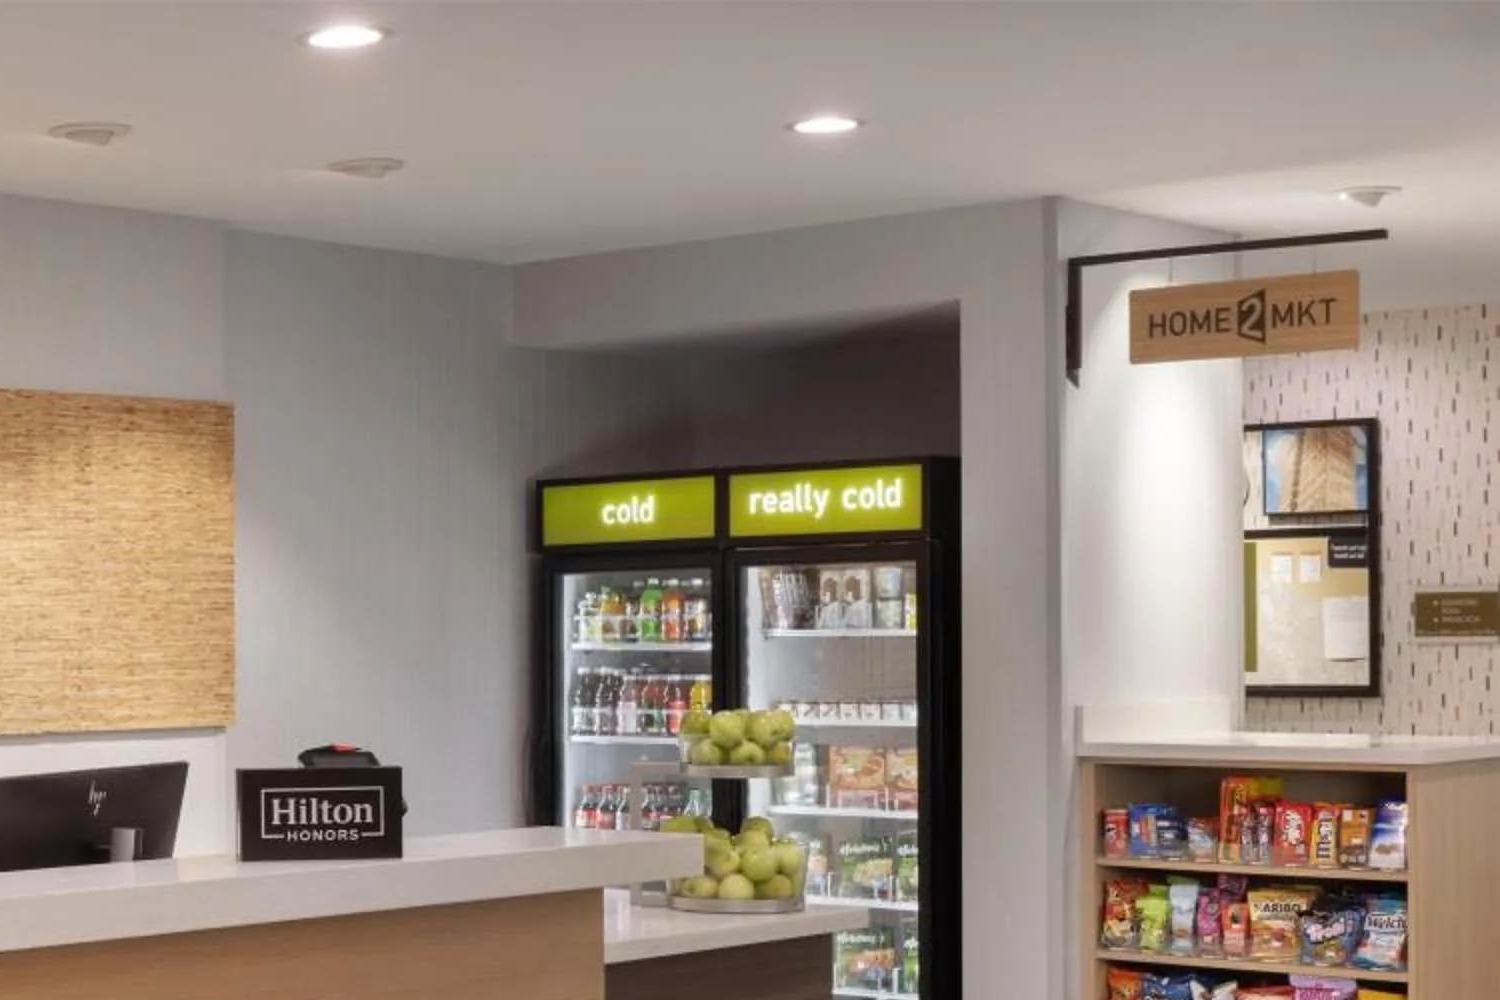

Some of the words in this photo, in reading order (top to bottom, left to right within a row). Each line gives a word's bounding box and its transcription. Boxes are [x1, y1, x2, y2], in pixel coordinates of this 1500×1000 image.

[1271, 298, 1338, 329] MKT
[601, 495, 655, 525] cold
[748, 482, 829, 517] really
[841, 477, 904, 510] cold
[271, 797, 374, 826] Hilton
[286, 828, 360, 843] HONORS
